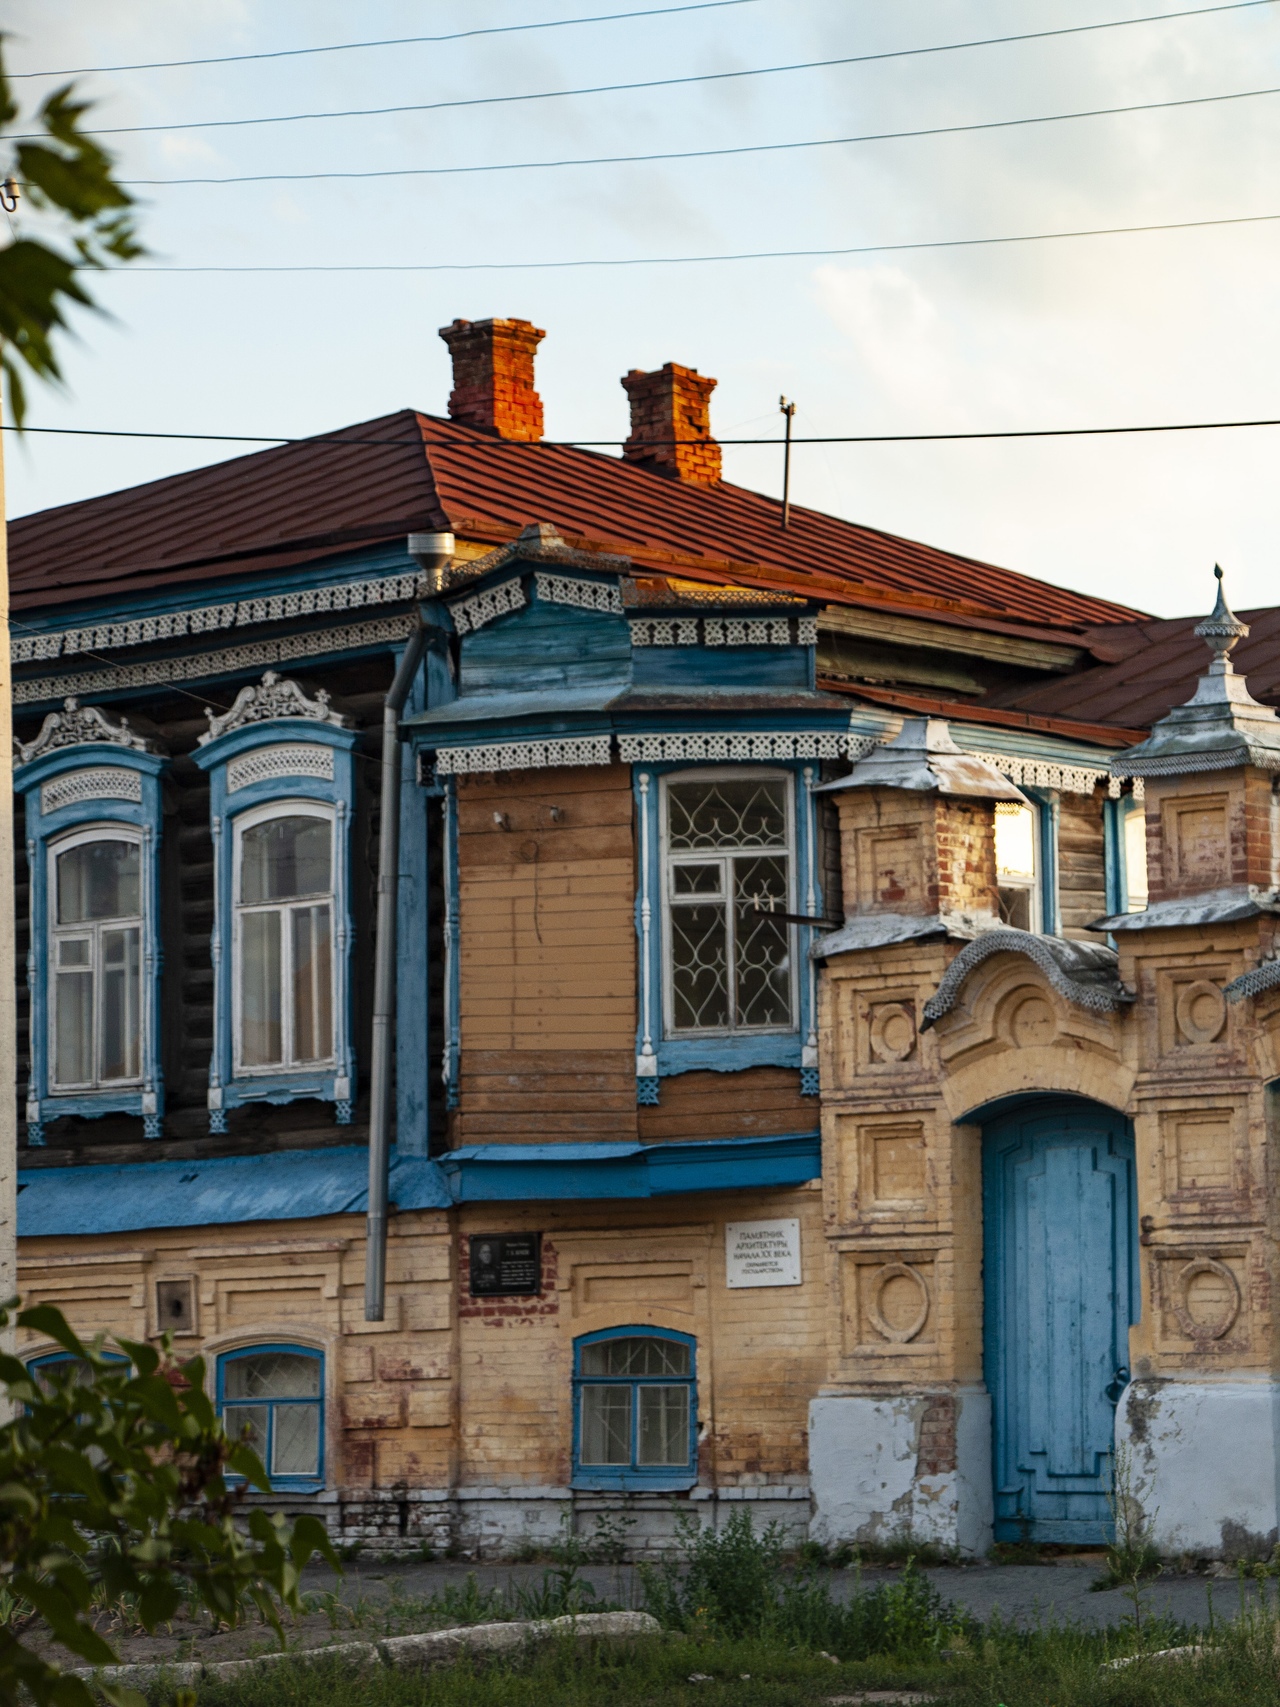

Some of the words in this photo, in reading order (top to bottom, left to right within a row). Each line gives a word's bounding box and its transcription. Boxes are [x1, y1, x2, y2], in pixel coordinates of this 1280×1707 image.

[739, 1230, 784, 1240] ПАМЯТНИК
[736, 1240, 787, 1250] АРХИТЕКТУРЫ
[733, 1252, 760, 1260] НАЧАЛА
[774, 1250, 792, 1258] ВЕКА
